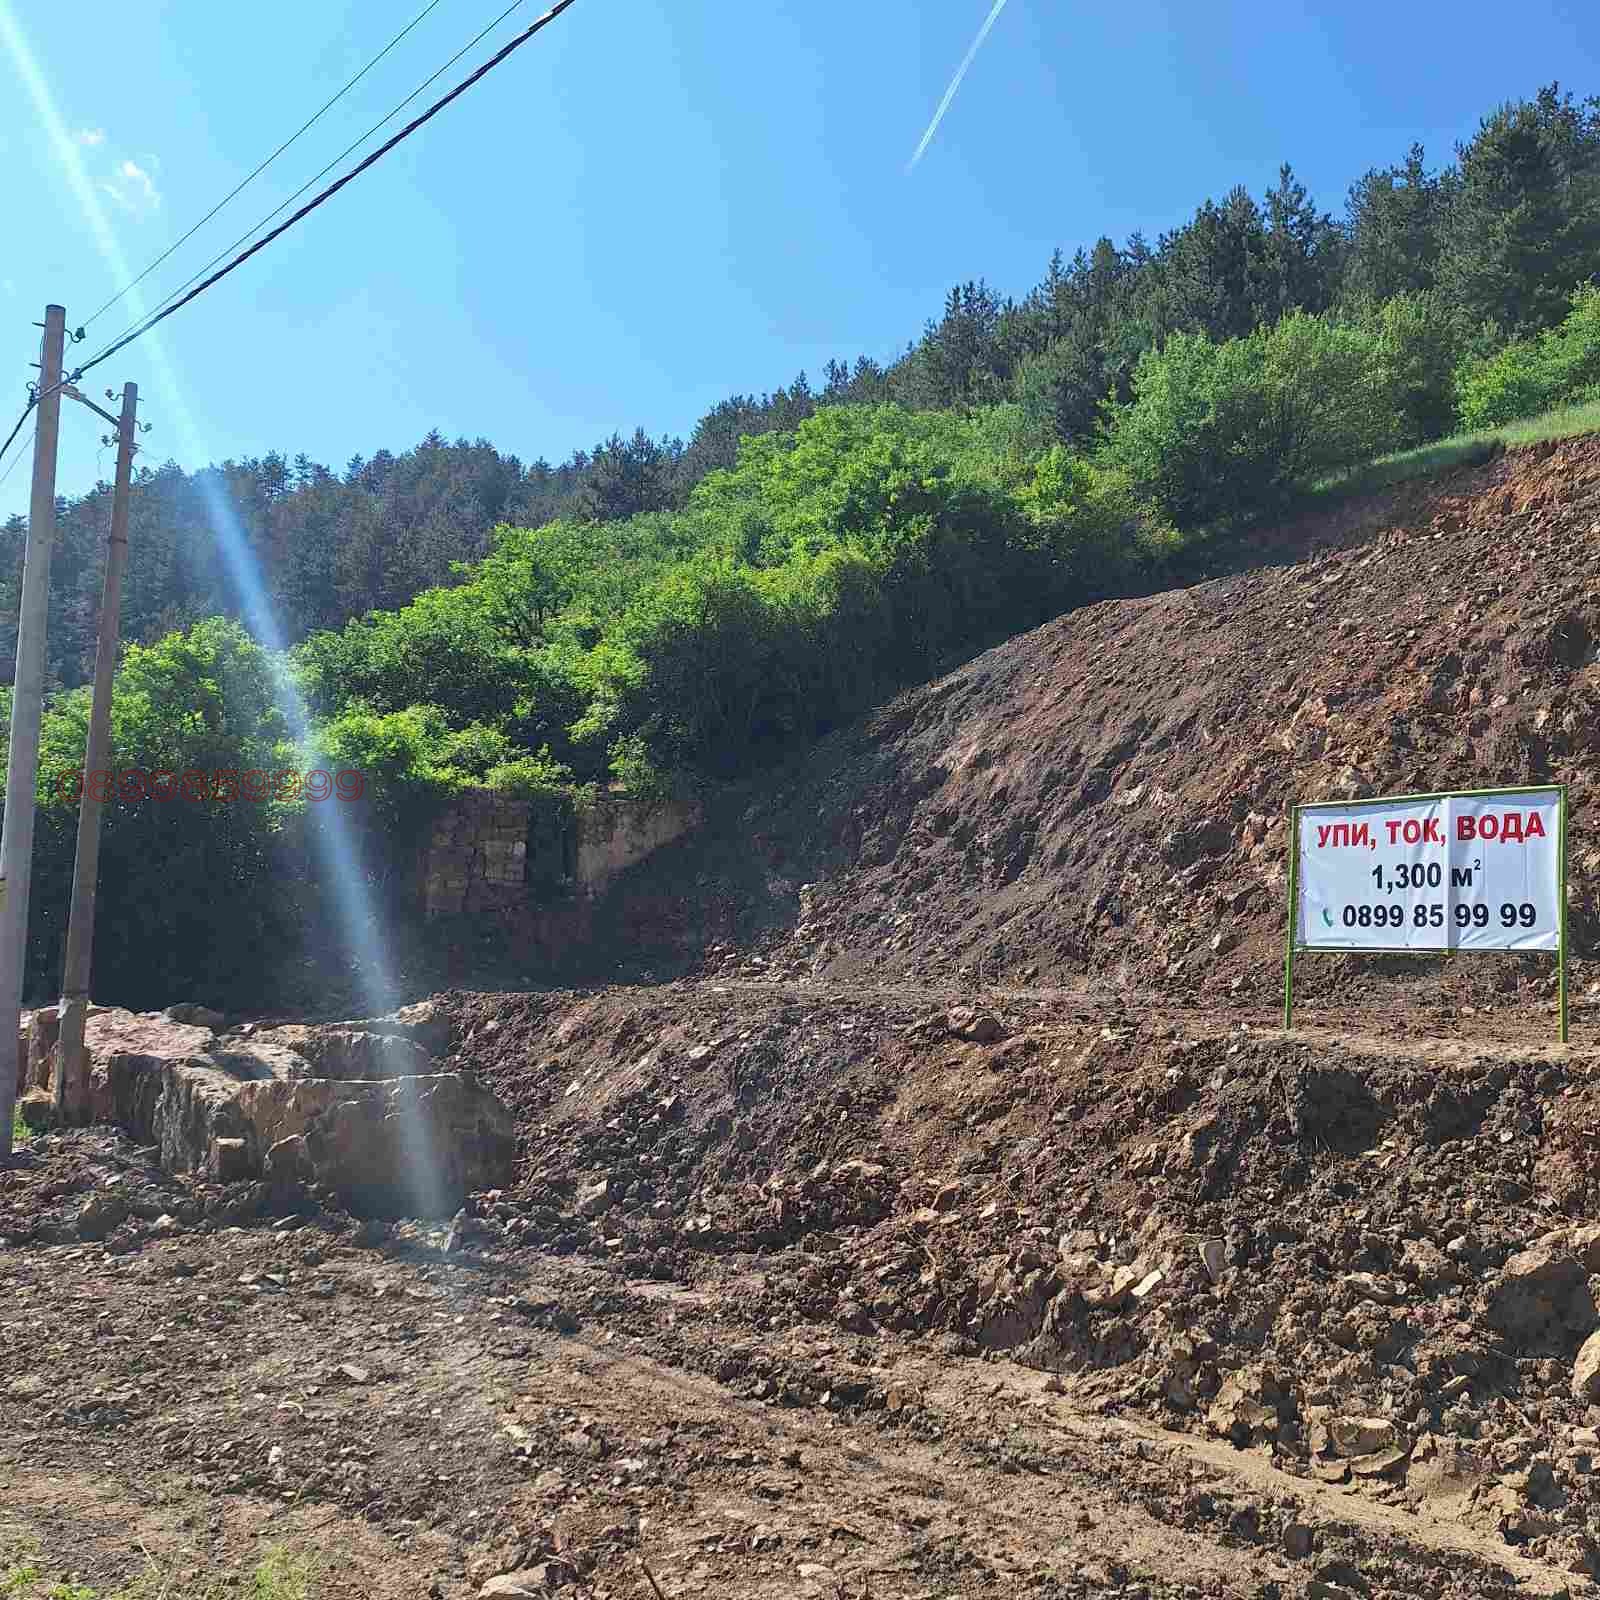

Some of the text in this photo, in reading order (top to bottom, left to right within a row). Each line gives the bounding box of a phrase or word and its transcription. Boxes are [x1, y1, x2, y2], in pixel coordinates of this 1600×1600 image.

[1317, 811, 1546, 850] УПИ, ТОК, ВОДА
[1371, 862, 1442, 894] 1,300
[1342, 903, 1537, 928] 0899 85 99 99
